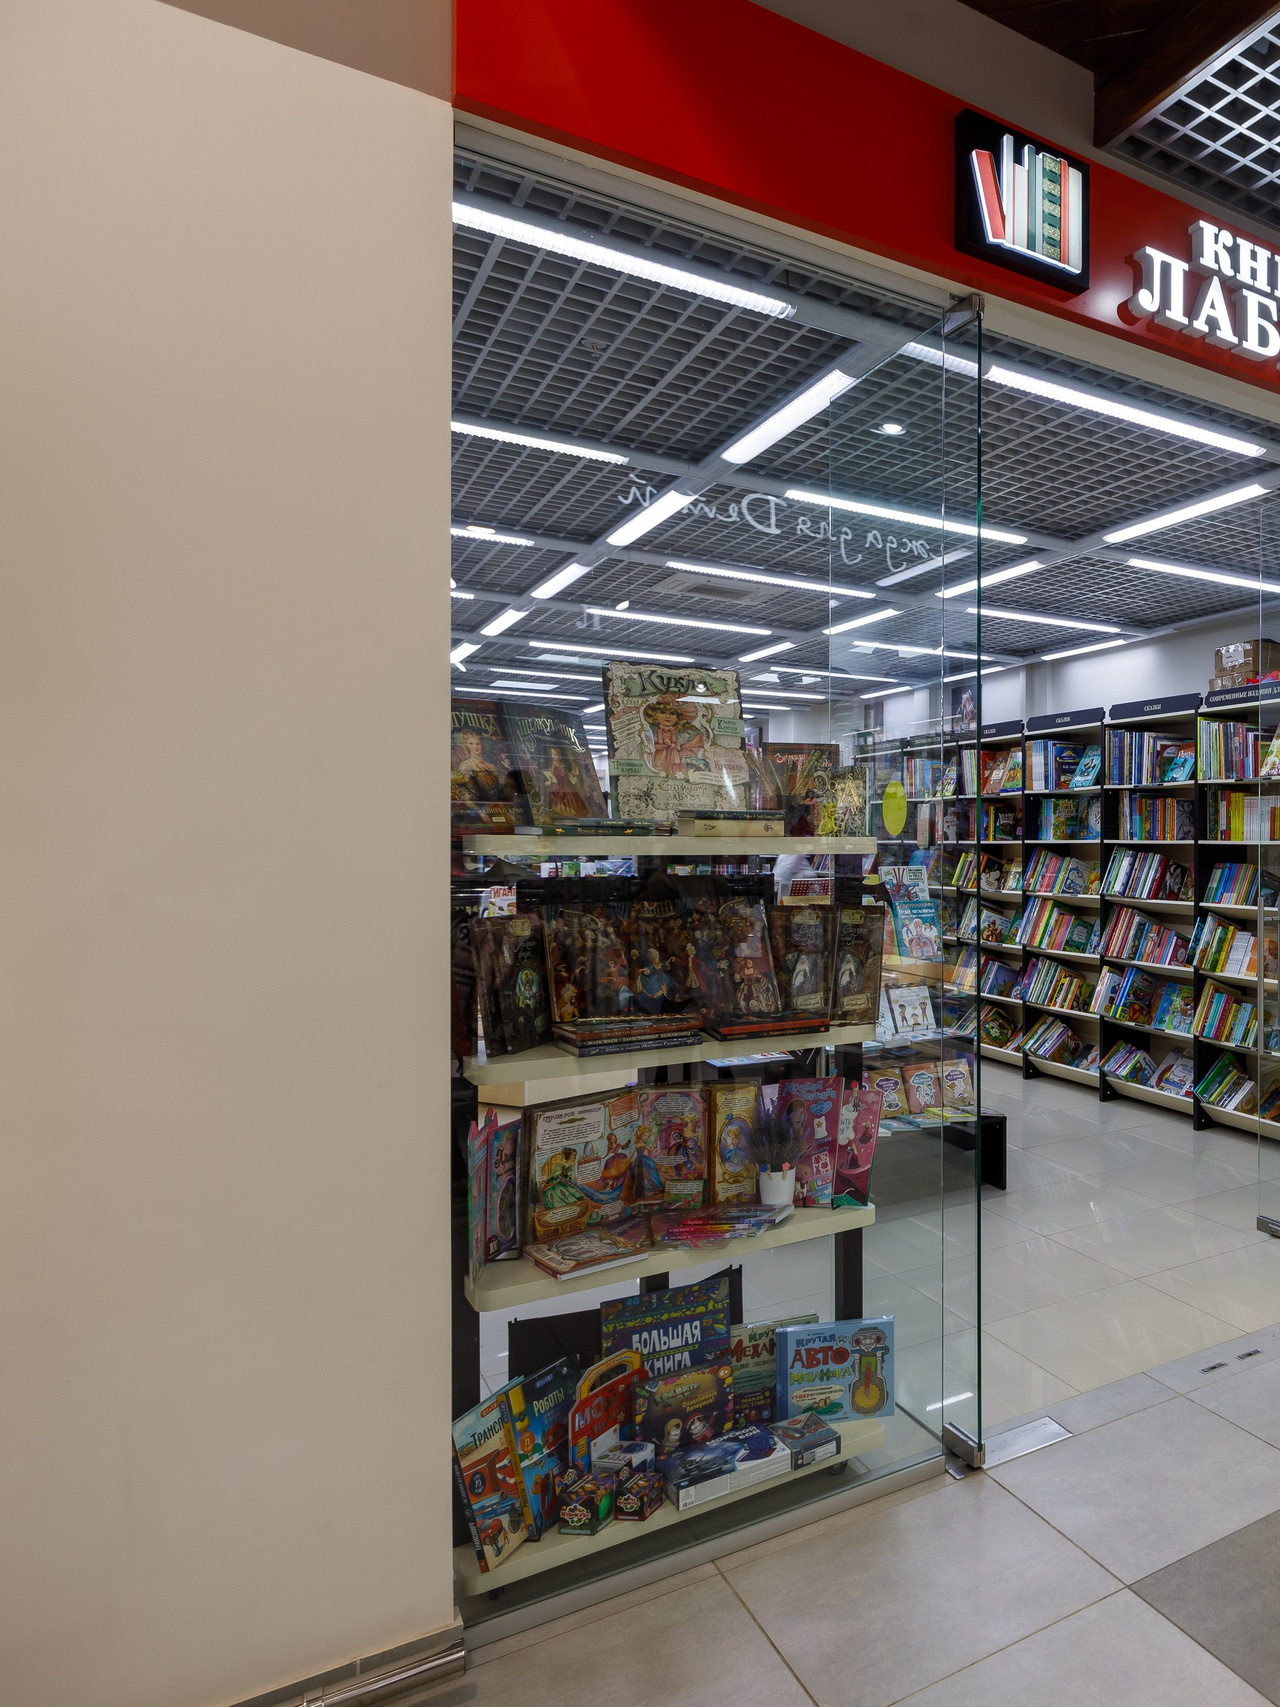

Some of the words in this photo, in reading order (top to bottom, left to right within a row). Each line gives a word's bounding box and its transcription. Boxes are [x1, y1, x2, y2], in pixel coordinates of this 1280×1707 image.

[1209, 690, 1248, 703] СОВРЕМЕННЫЕ
[1143, 703, 1162, 712] СКАЗКИ
[632, 1320, 702, 1356] БОЛЬШАЯ
[795, 1333, 837, 1348] КРУТАЯ
[644, 1352, 692, 1378] КНИГА
[789, 1346, 850, 1370] АВТО
[789, 1366, 852, 1386] МЕХАНИКА
[532, 1388, 565, 1417] РОБОТЫ
[705, 1425, 757, 1445] МОРСКОЙ
[738, 1428, 761, 1440] БОЙ
